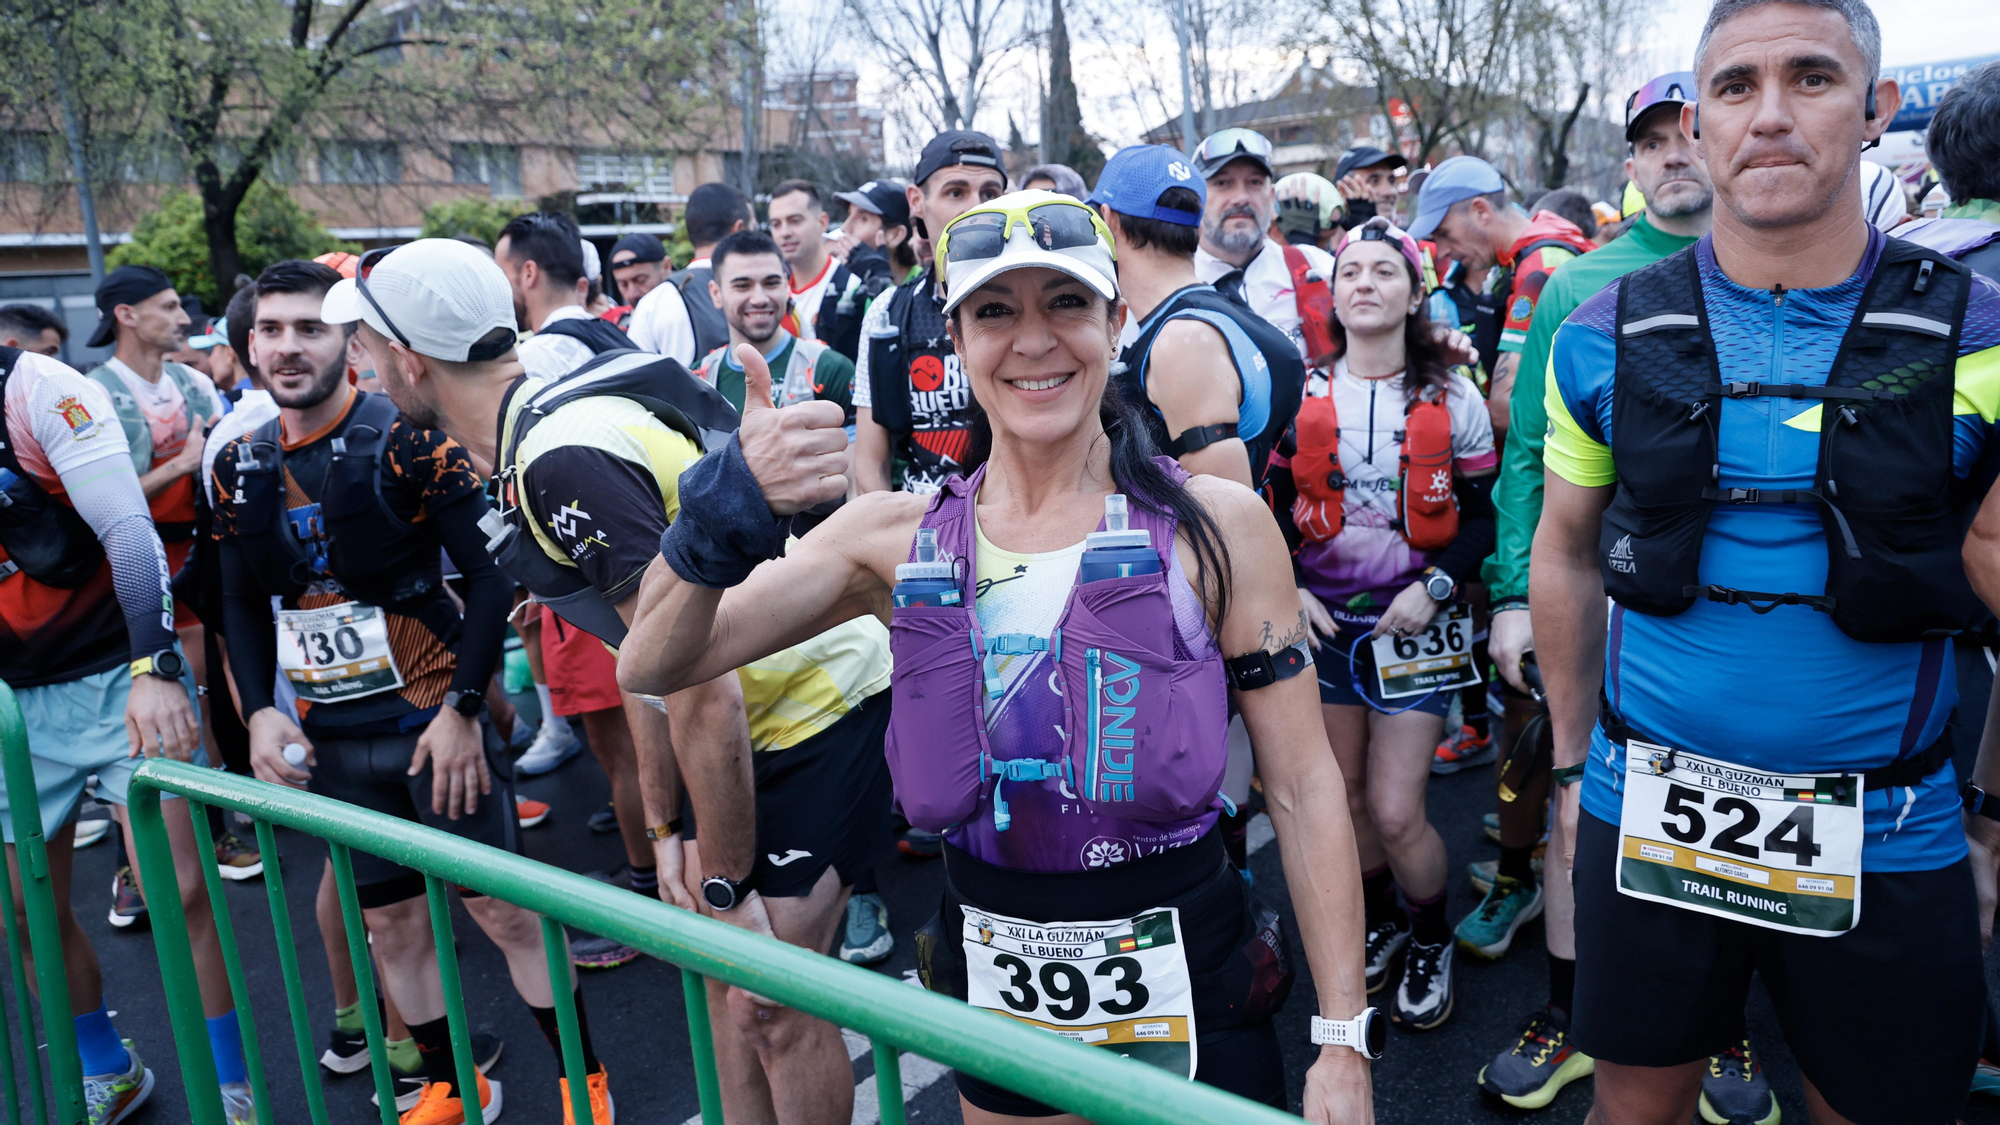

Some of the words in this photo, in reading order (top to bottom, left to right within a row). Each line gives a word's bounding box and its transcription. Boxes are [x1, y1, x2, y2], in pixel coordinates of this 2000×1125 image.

[297, 626, 364, 666] 130
[1393, 622, 1464, 661] 636
[1686, 759, 1704, 773] XXI
[1707, 764, 1723, 777] LA
[1725, 770, 1785, 787] GUZMÁN
[1701, 775, 1715, 787] EL
[1718, 779, 1761, 797] BUENO
[1132, 834, 1157, 843] centro
[1159, 833, 1168, 842] de
[1661, 783, 1822, 867] 524
[1714, 866, 1733, 876] ALFONSO
[1733, 869, 1749, 879] GARCÍA
[1681, 879, 1723, 900] TRAIL
[1726, 890, 1787, 915] RUNING
[1007, 925, 1026, 939] XXI
[1028, 929, 1044, 941] LA
[1047, 929, 1105, 943] GUZMÁN
[1022, 943, 1036, 955] EL
[1038, 946, 1083, 958] BUENO
[993, 953, 1150, 1021] 393
